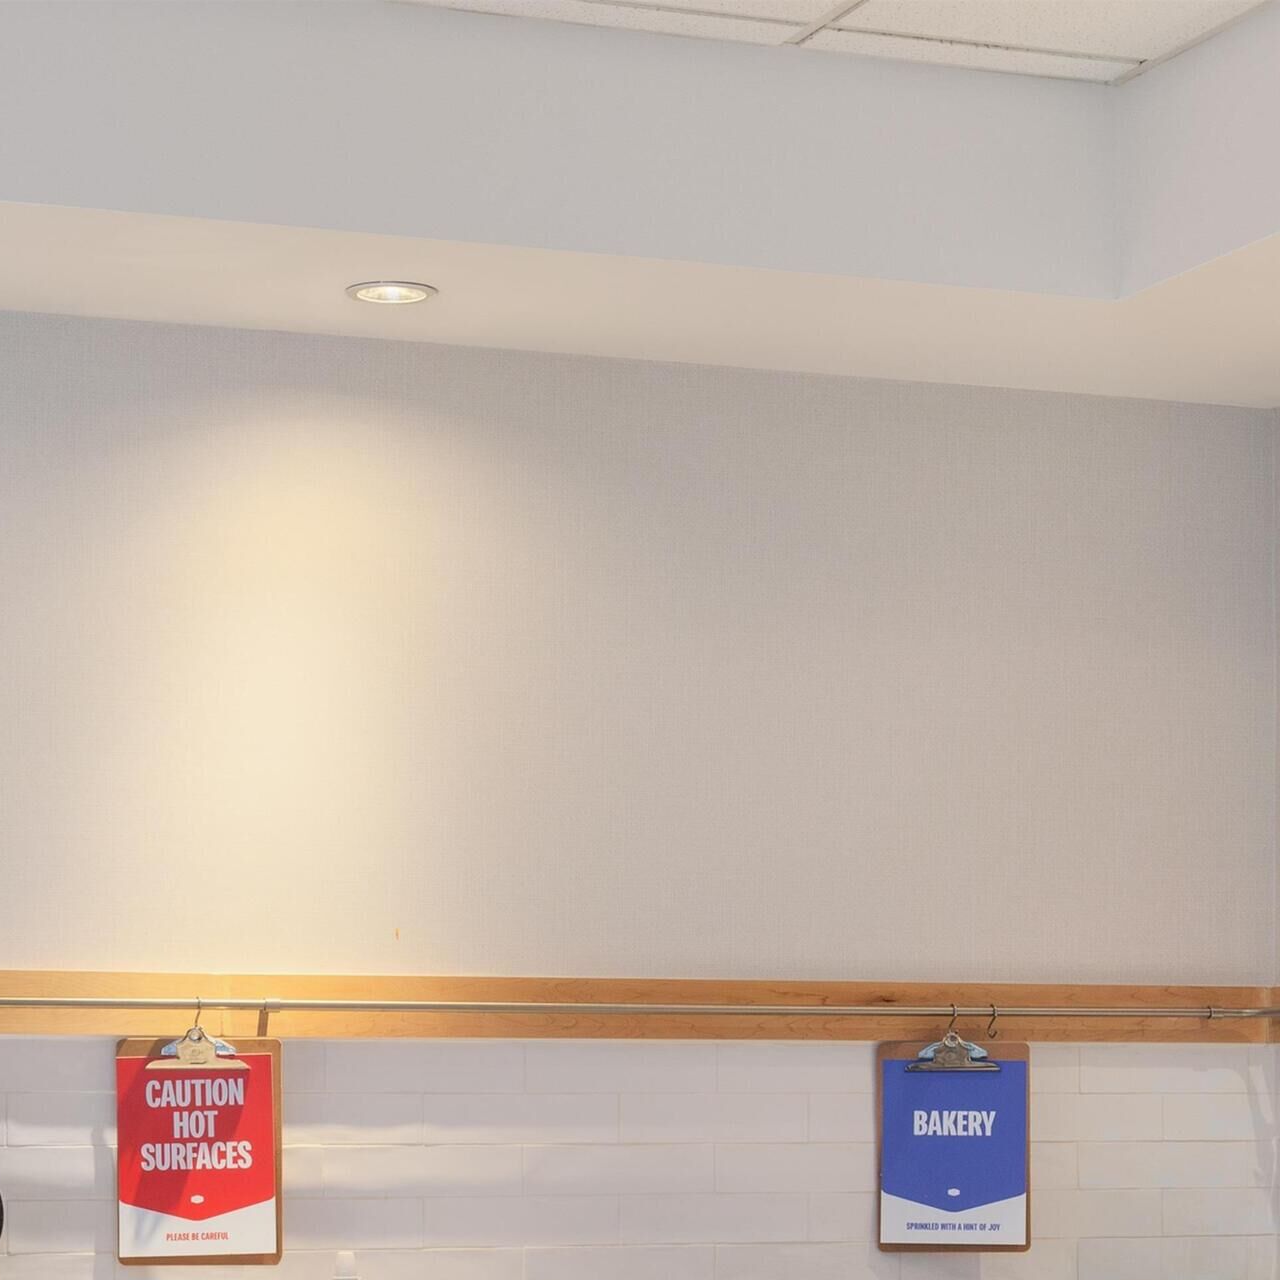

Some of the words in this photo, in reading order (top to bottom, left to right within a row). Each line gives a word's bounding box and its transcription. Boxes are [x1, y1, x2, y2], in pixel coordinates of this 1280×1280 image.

[145, 1078, 245, 1108] CAUTION
[172, 1110, 218, 1139] HOT
[913, 1110, 996, 1136] BAKERY
[140, 1140, 253, 1171] SURFACES
[166, 1232, 190, 1241] PLEASE
[191, 1232, 200, 1241] BE
[201, 1231, 229, 1240] CAREFUL
[906, 1222, 940, 1231] SPRINKLED
[940, 1223, 957, 1231] WITH
